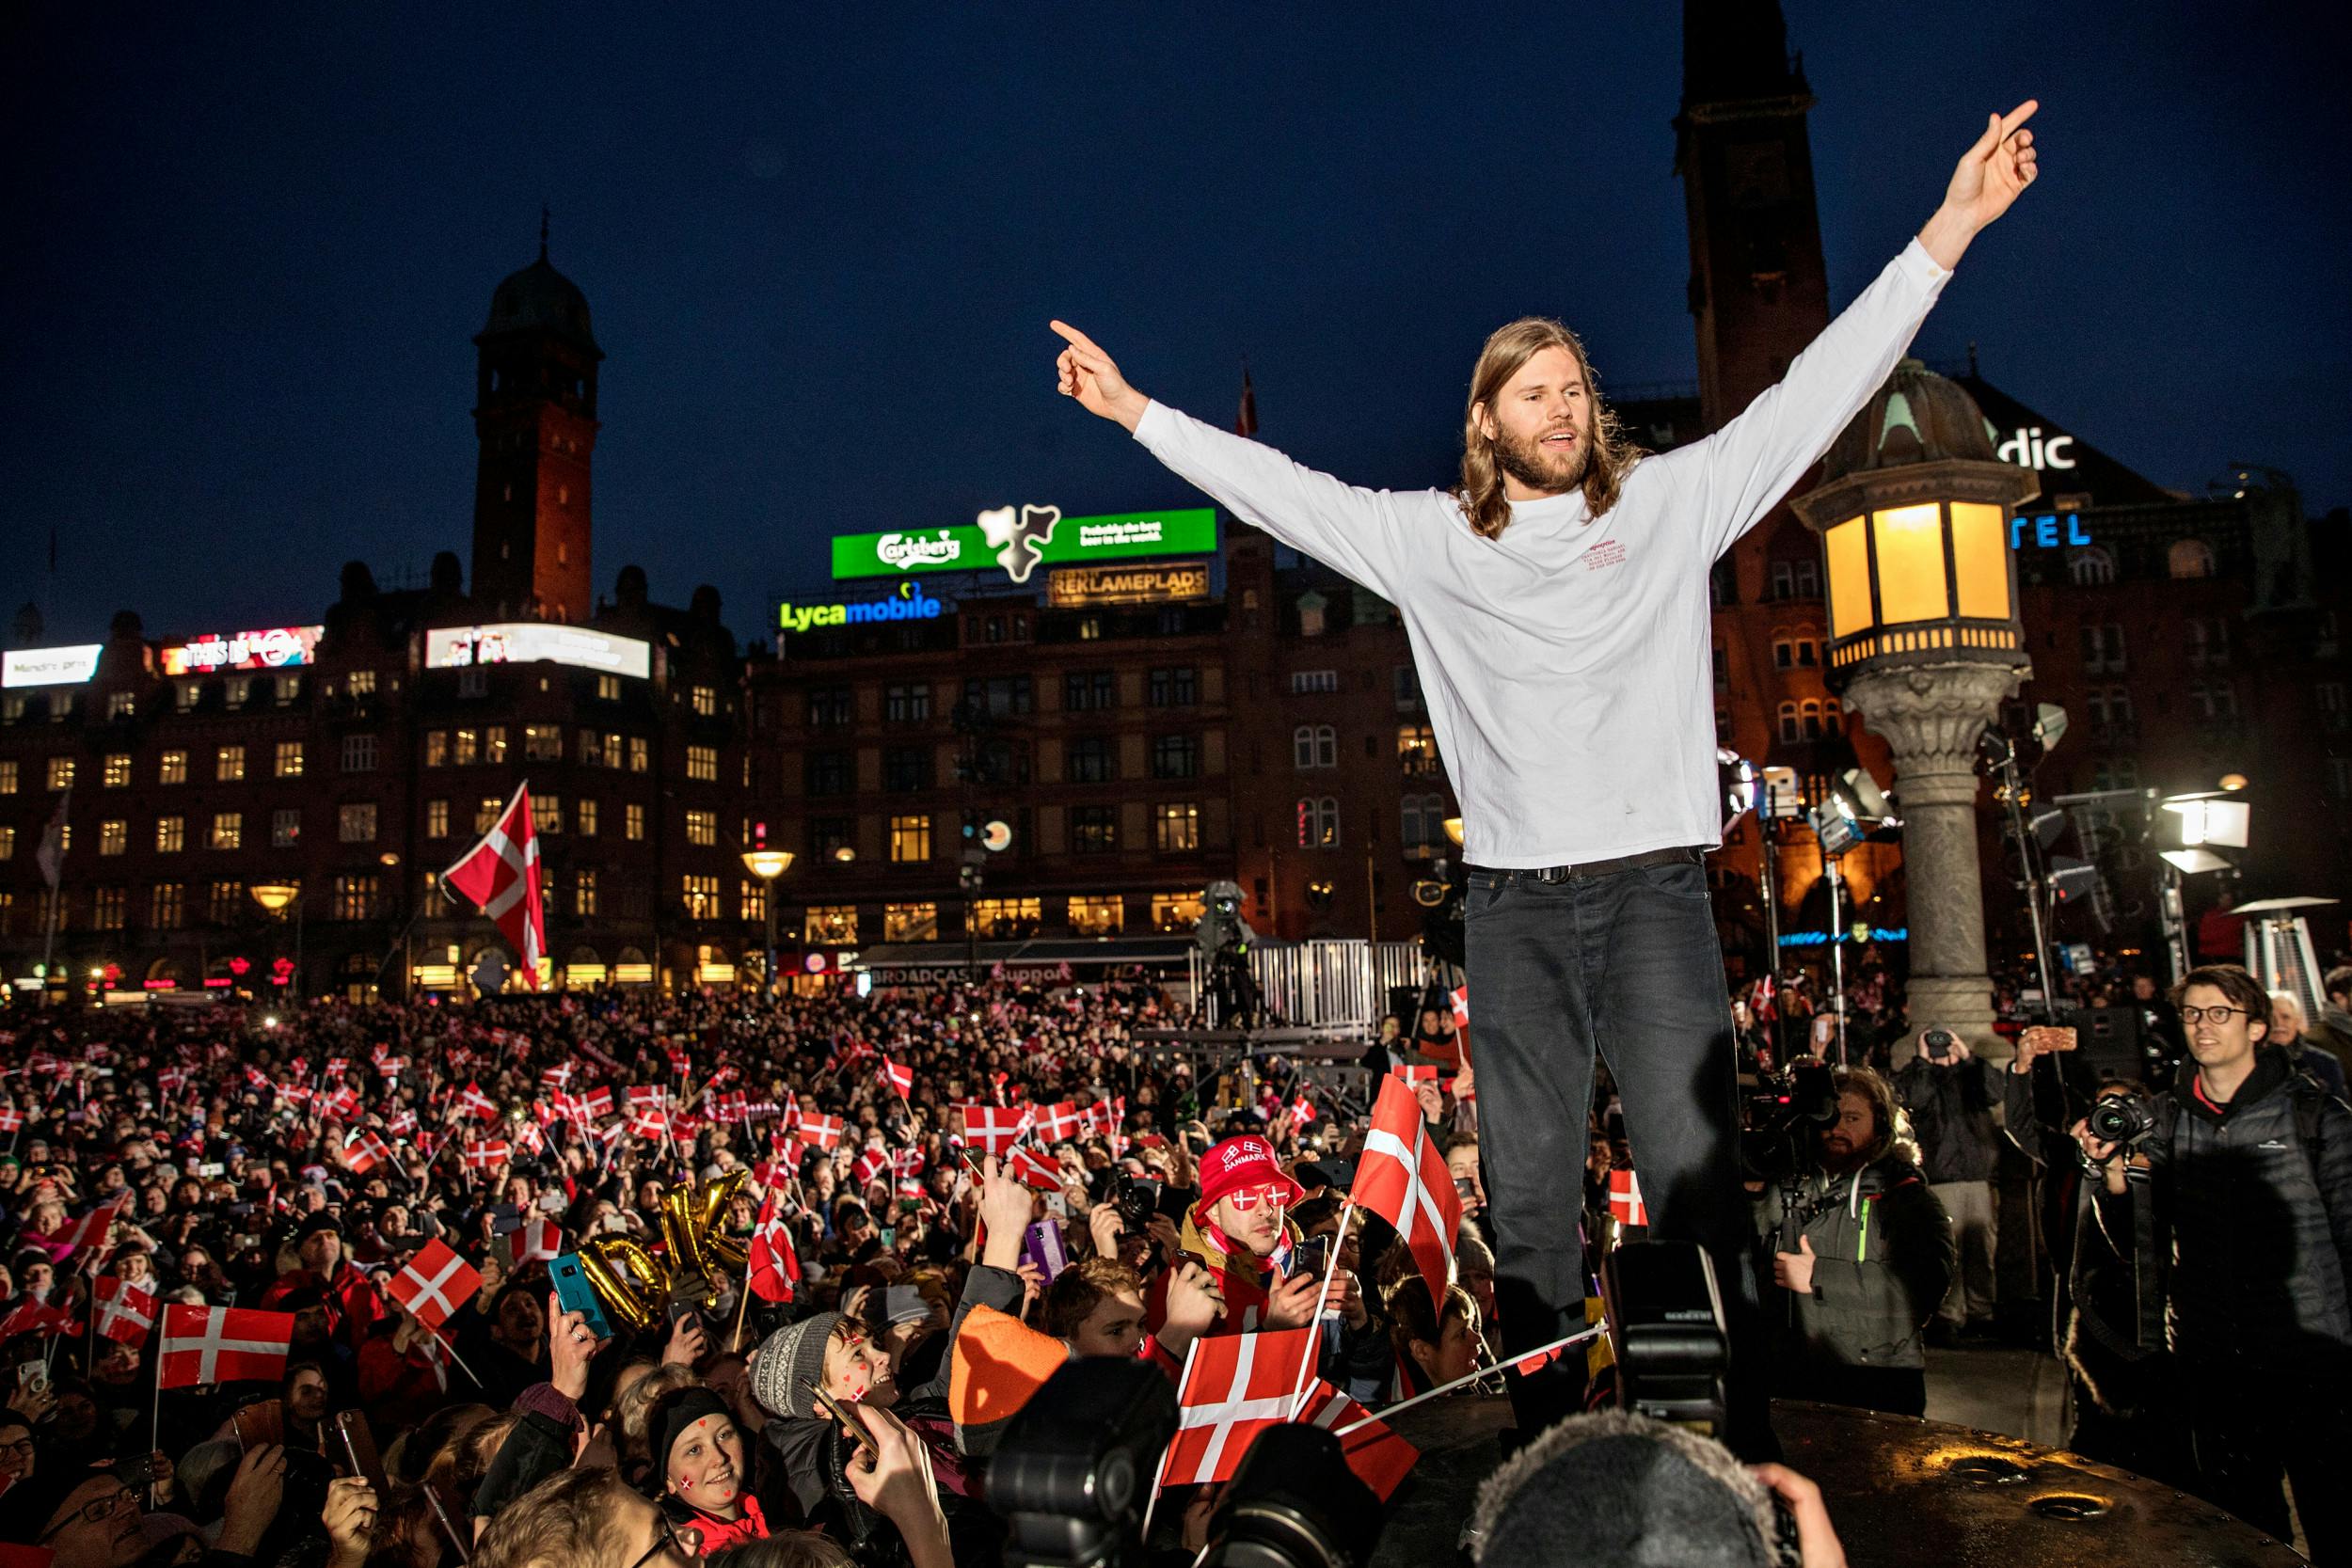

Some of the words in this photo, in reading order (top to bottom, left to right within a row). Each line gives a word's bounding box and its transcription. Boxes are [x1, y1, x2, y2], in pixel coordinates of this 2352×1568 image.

[1080, 524, 1123, 538] Probably
[1123, 522, 1139, 532] the
[1139, 521, 1162, 532] best
[877, 530, 961, 570] Carlsberg
[1054, 572, 1205, 594] REKLAMEPLADS
[780, 582, 942, 632] Lycamobile
[871, 967, 982, 985] BROADCAS
[1225, 1153, 1267, 1172] DANMARK
